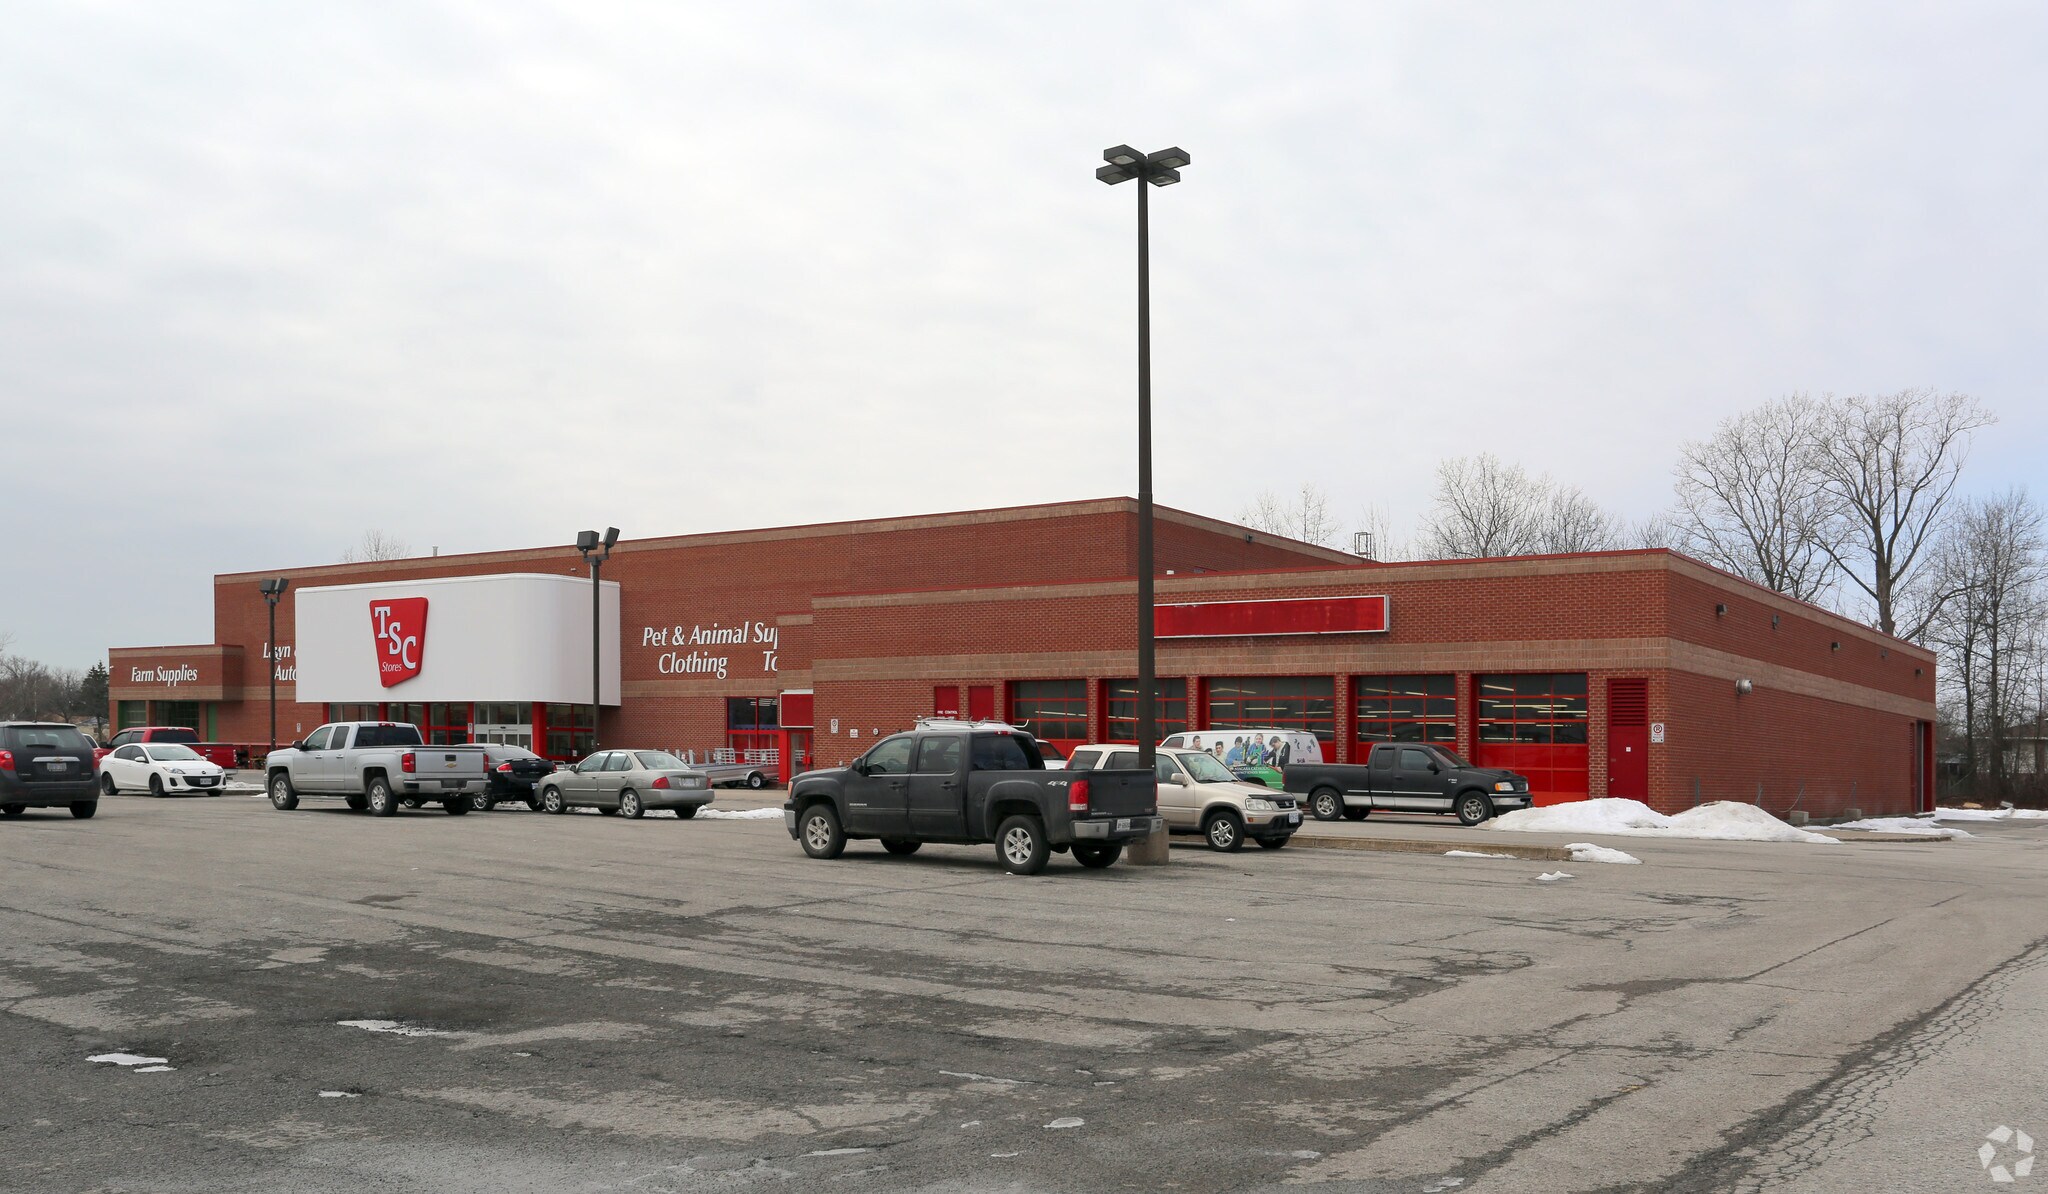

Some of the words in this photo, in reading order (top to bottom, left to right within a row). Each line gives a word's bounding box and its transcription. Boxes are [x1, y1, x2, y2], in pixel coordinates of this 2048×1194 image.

[375, 606, 416, 669] TSC
[642, 627, 668, 646] Pet
[671, 625, 685, 646] &
[688, 621, 750, 645] Animal
[263, 642, 291, 658] Lwn
[131, 666, 154, 682] Farm
[156, 664, 198, 687] Supplies
[381, 661, 402, 673] Stores
[658, 651, 728, 680] Clothing
